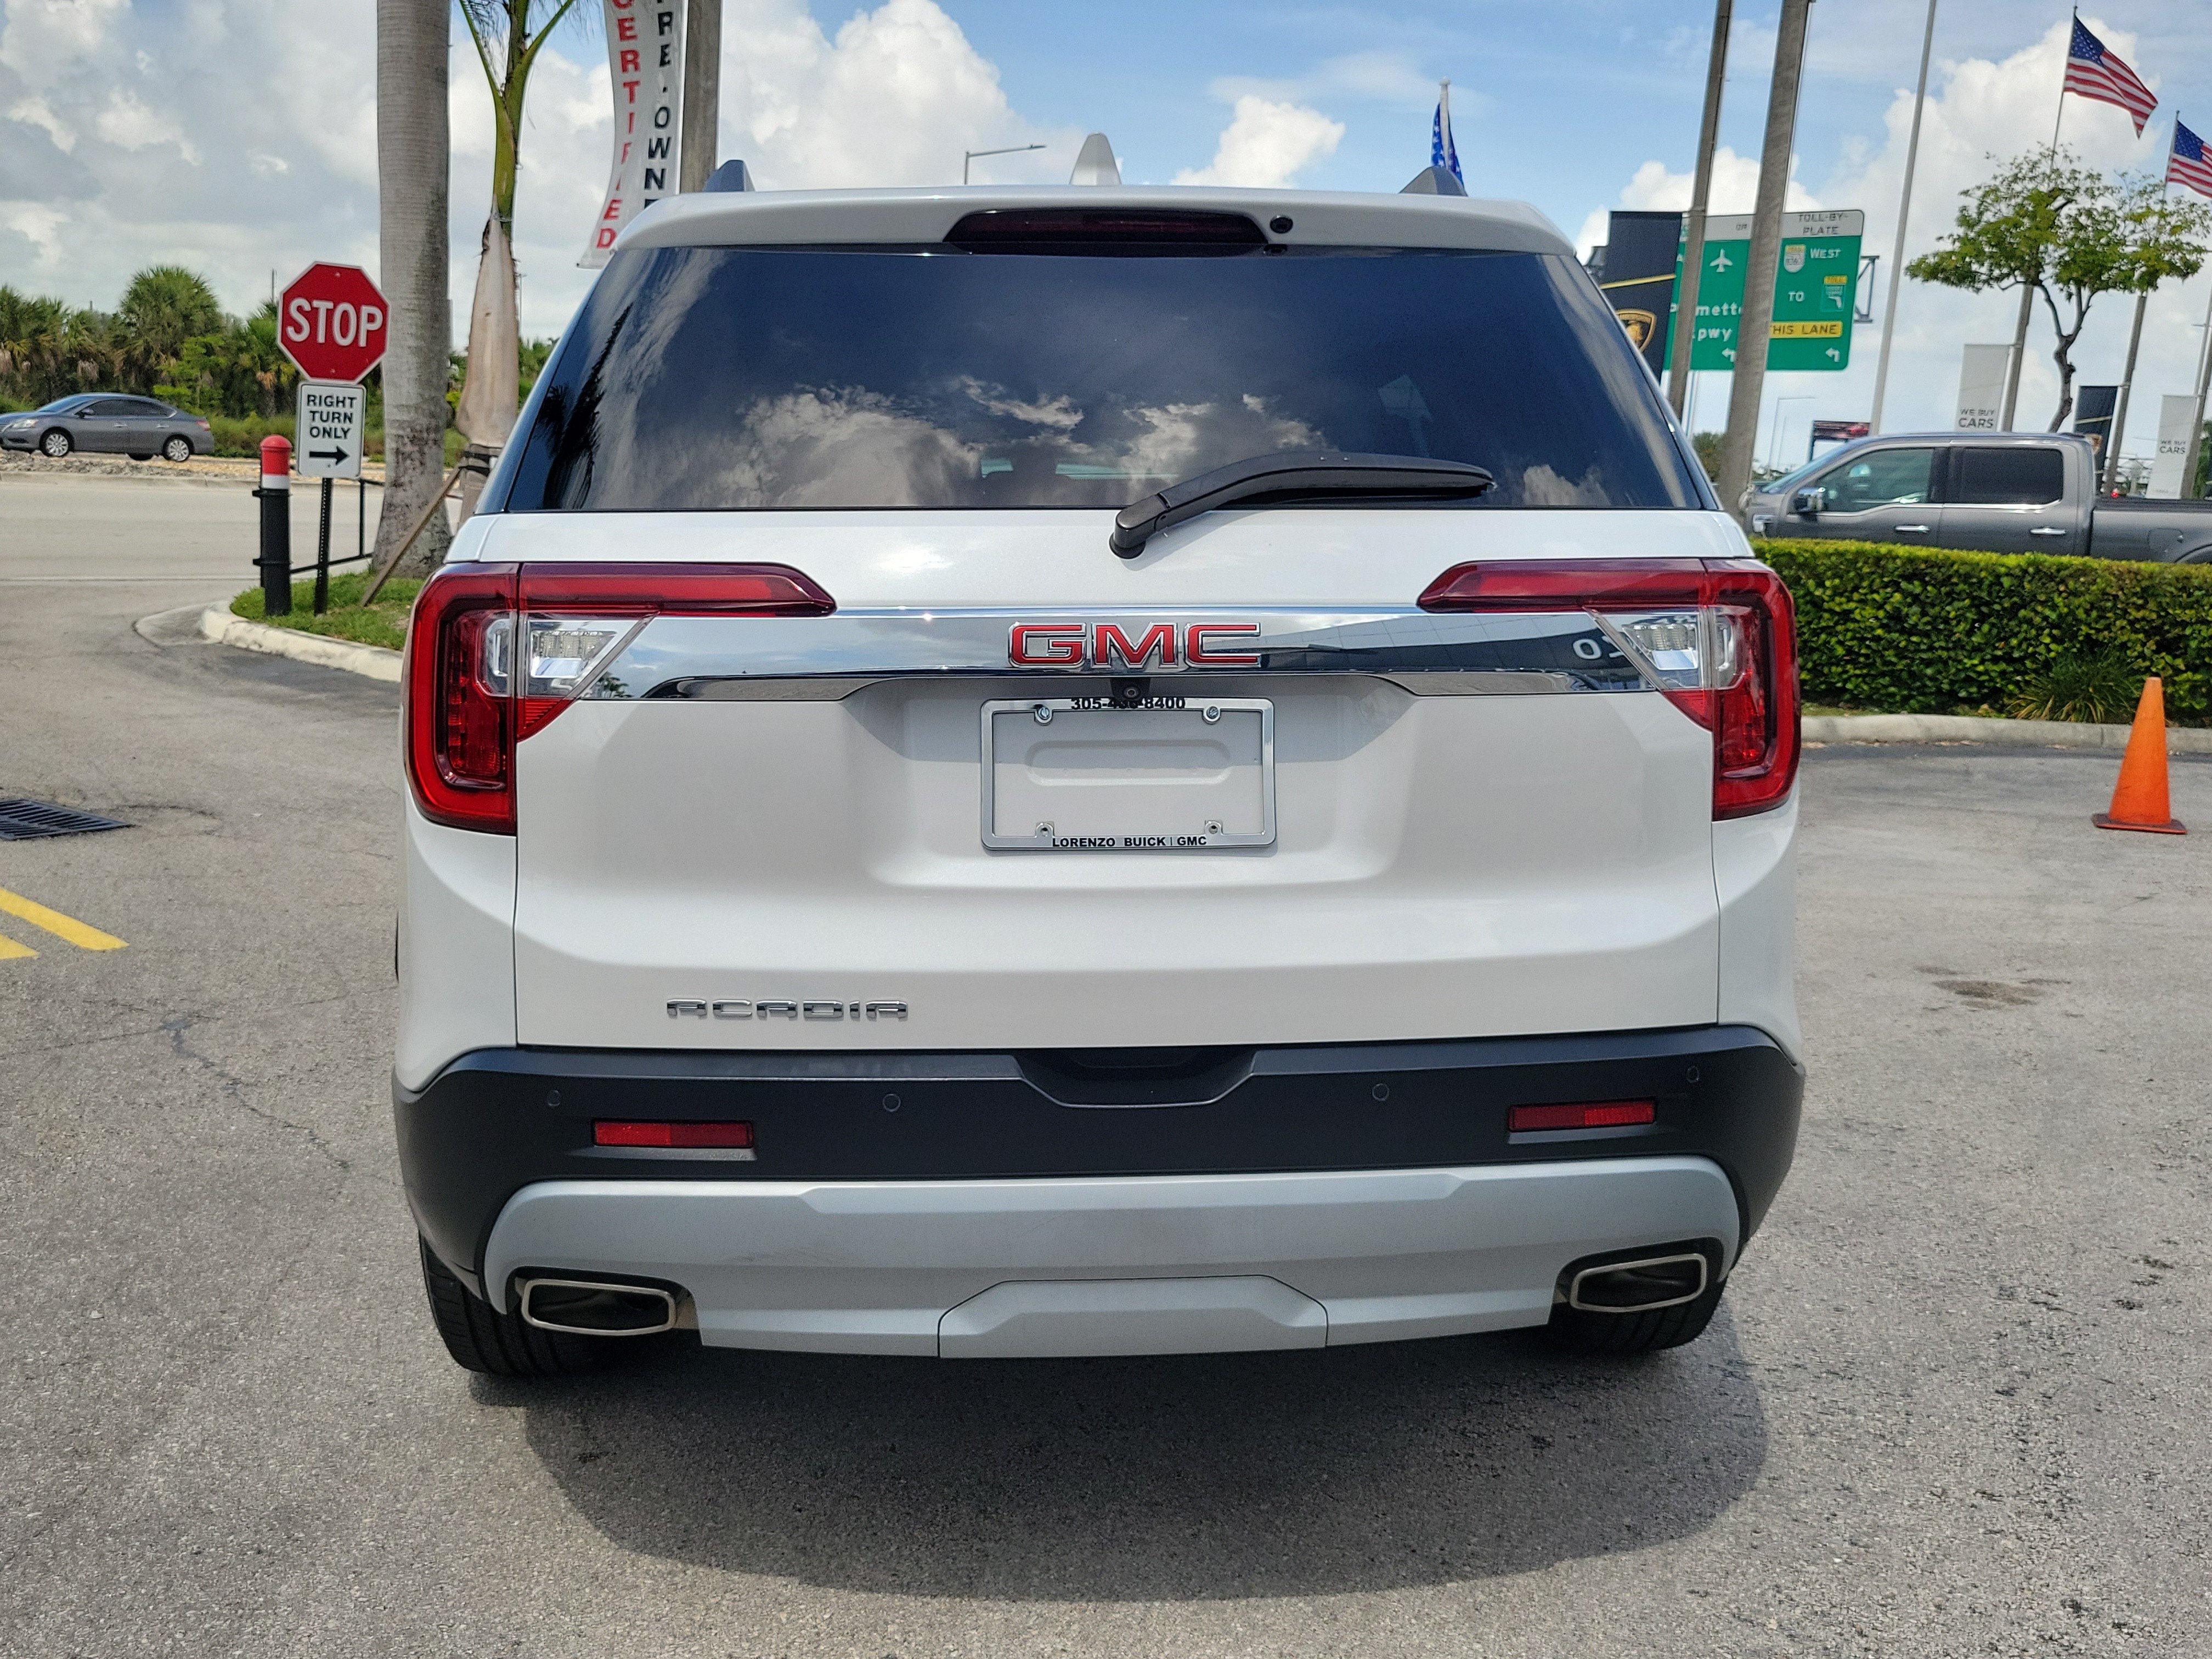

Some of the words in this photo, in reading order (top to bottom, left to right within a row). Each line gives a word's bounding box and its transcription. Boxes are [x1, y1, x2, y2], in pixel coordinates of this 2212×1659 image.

[1803, 226, 1838, 235] PLATE
[1810, 247, 1841, 259] WEST
[1788, 291, 1805, 302] TO
[286, 297, 383, 348] STOP
[1770, 324, 1794, 335] HIS
[1801, 324, 1837, 335] LANE
[307, 394, 357, 409] RIGHT
[309, 410, 354, 424] TURN
[1959, 417, 1994, 428] CARS
[309, 426, 352, 439] ONLY
[2159, 446, 2186, 454] CARS
[1008, 621, 1262, 669] GMC
[1052, 837, 1116, 847] LORENZO
[1124, 837, 1166, 847] BUICK
[1177, 836, 1207, 846] GMC
[667, 998, 909, 1020] ACADIA
